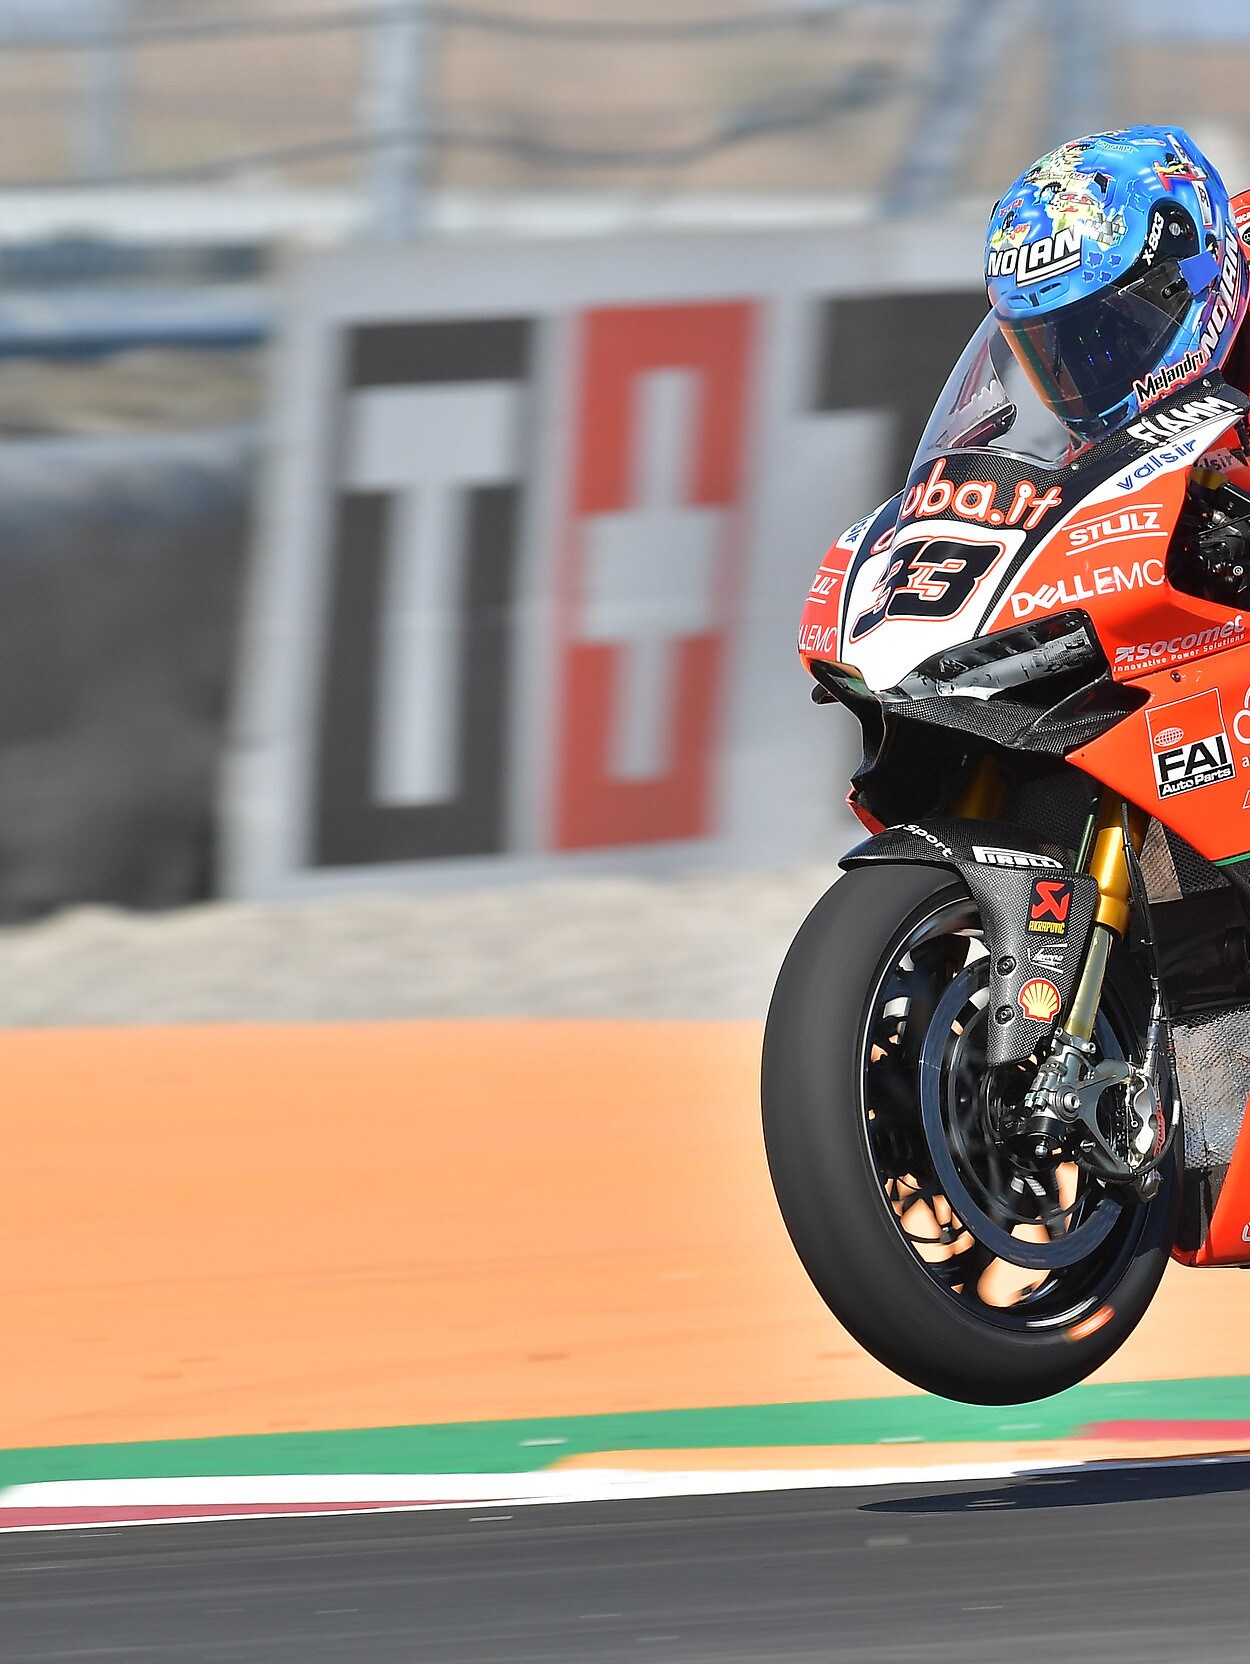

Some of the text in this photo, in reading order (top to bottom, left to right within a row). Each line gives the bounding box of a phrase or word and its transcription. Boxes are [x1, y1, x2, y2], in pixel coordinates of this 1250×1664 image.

[986, 222, 1082, 286] NOLAN
[1199, 225, 1239, 360] NOLAN
[1134, 352, 1206, 403] Melandri
[1126, 395, 1239, 443] FIAMM
[1116, 438, 1197, 491] valsir
[1068, 511, 1161, 547] STULZ
[1113, 633, 1246, 673] Innovative Power Solutions
[1135, 614, 1246, 661] socomec
[1157, 736, 1230, 783] FAI
[1161, 766, 1232, 796] Auto Parts
[971, 845, 1065, 869] PIRELLI
